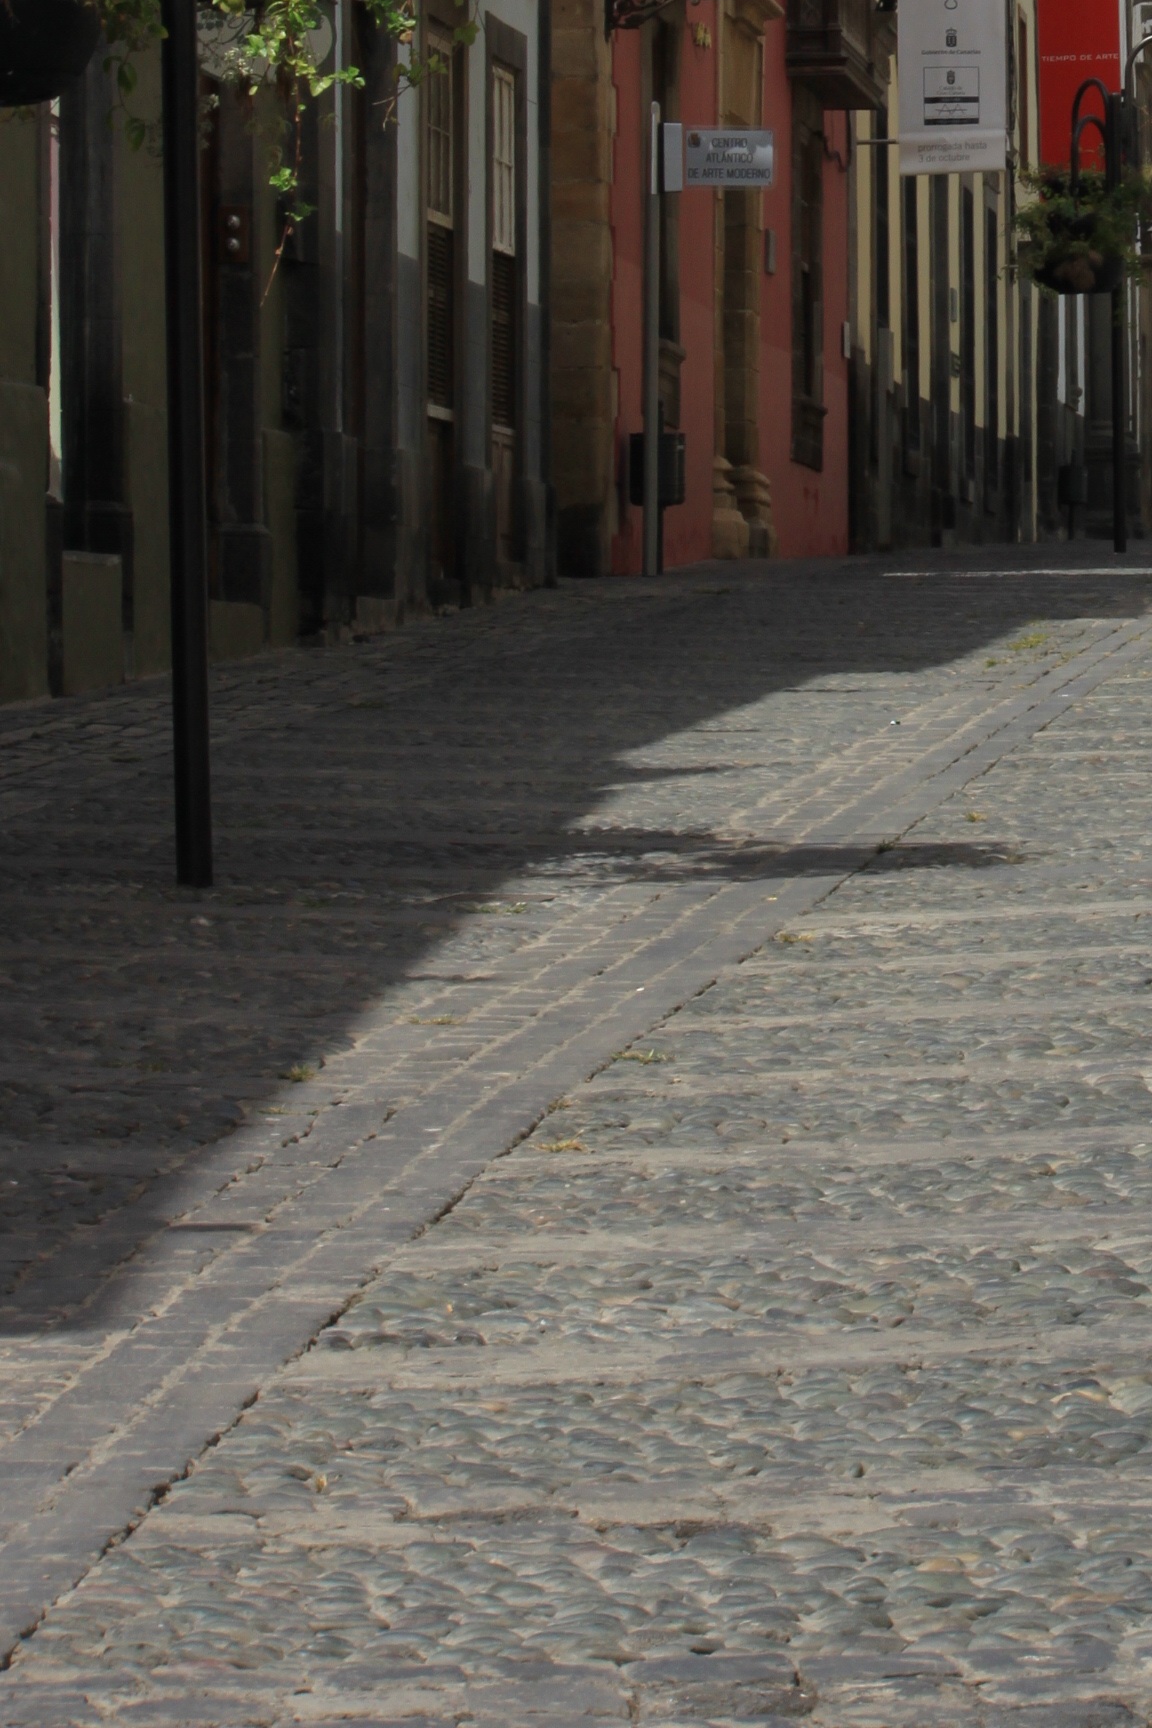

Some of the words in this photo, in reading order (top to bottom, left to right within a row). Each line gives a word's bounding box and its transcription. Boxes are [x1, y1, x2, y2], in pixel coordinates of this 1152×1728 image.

[1041, 54, 1077, 63] TIEMPO
[1079, 53, 1093, 61] DE
[1095, 52, 1119, 60] ARTE
[711, 138, 748, 149] CENTRO
[964, 139, 988, 150] hasta
[705, 151, 754, 164] ATLÁNTICO
[925, 154, 937, 163] de
[938, 152, 971, 162] octubre
[687, 168, 700, 179] DE
[702, 168, 724, 179] ARTE
[726, 168, 771, 179] MODERNO
